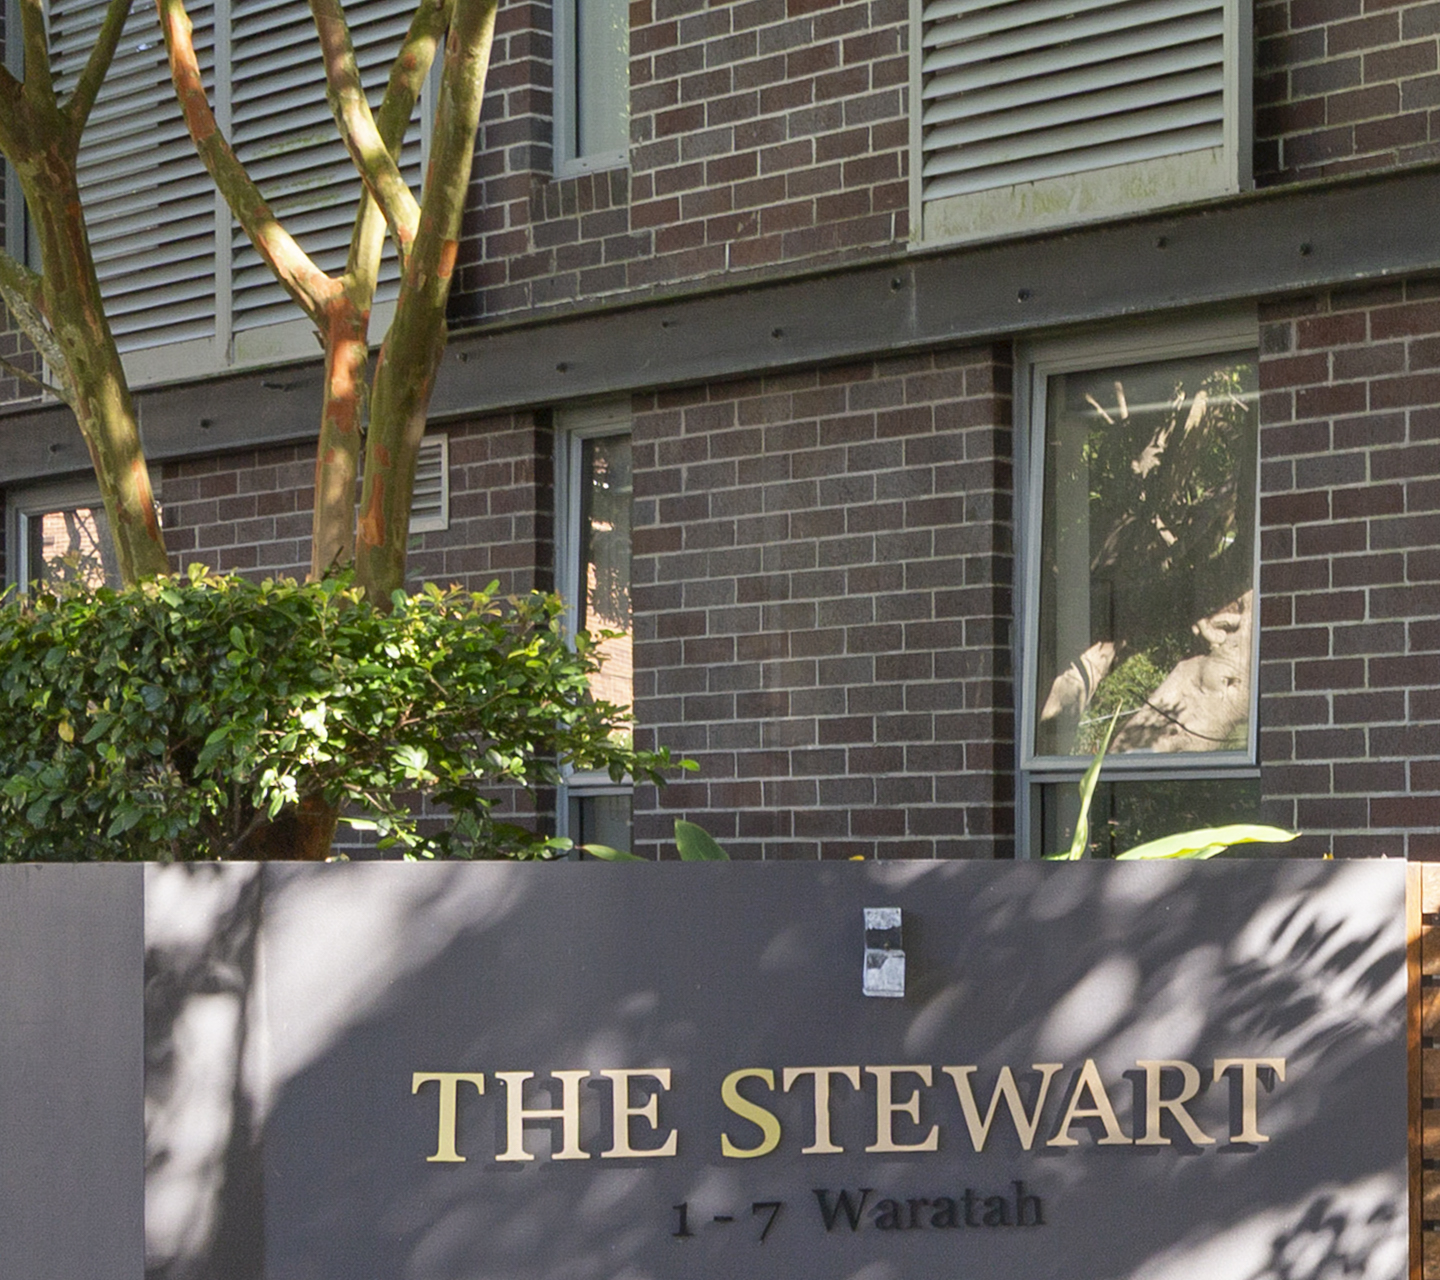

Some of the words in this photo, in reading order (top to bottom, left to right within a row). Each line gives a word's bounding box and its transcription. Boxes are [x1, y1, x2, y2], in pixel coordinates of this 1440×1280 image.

[411, 1068, 678, 1164] THE
[720, 1056, 1288, 1160] STEWART
[812, 1180, 1045, 1232] Waratah
